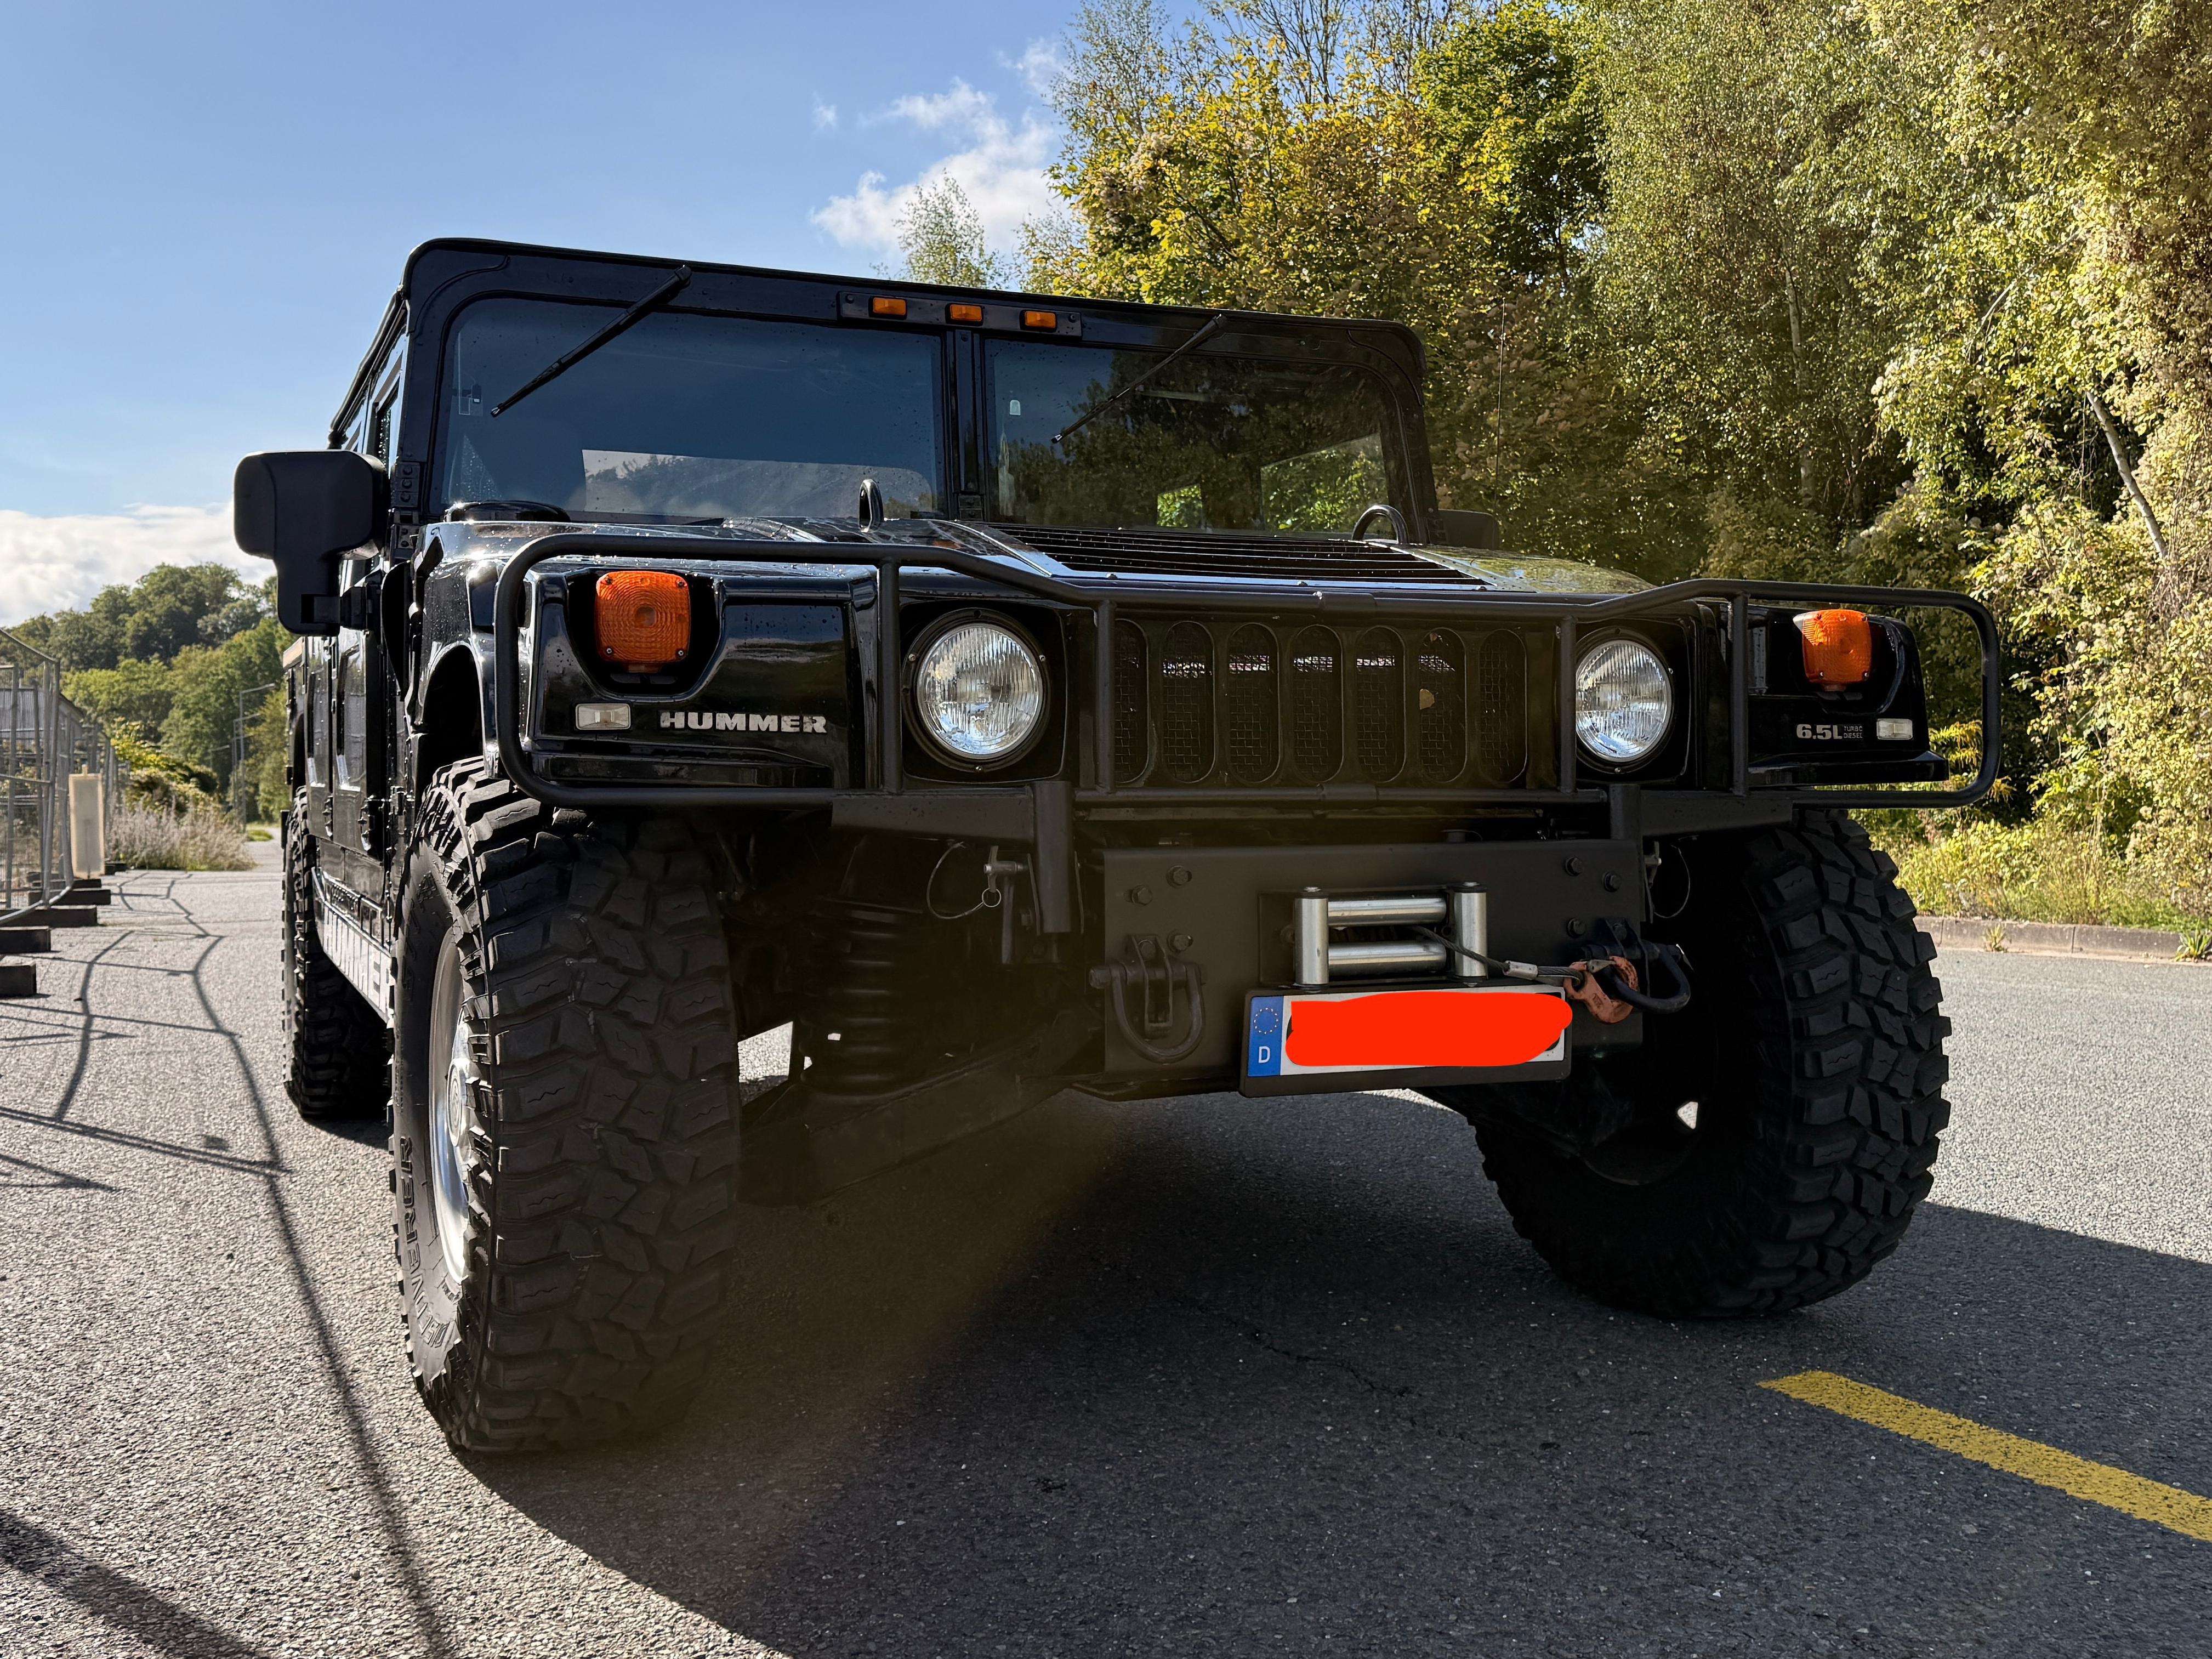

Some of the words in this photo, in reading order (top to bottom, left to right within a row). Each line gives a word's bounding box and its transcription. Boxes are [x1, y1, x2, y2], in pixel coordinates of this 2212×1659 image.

[659, 712, 827, 734] HUMMER
[1796, 724, 1843, 740] 6.5L
[1258, 1046, 1271, 1064] D
